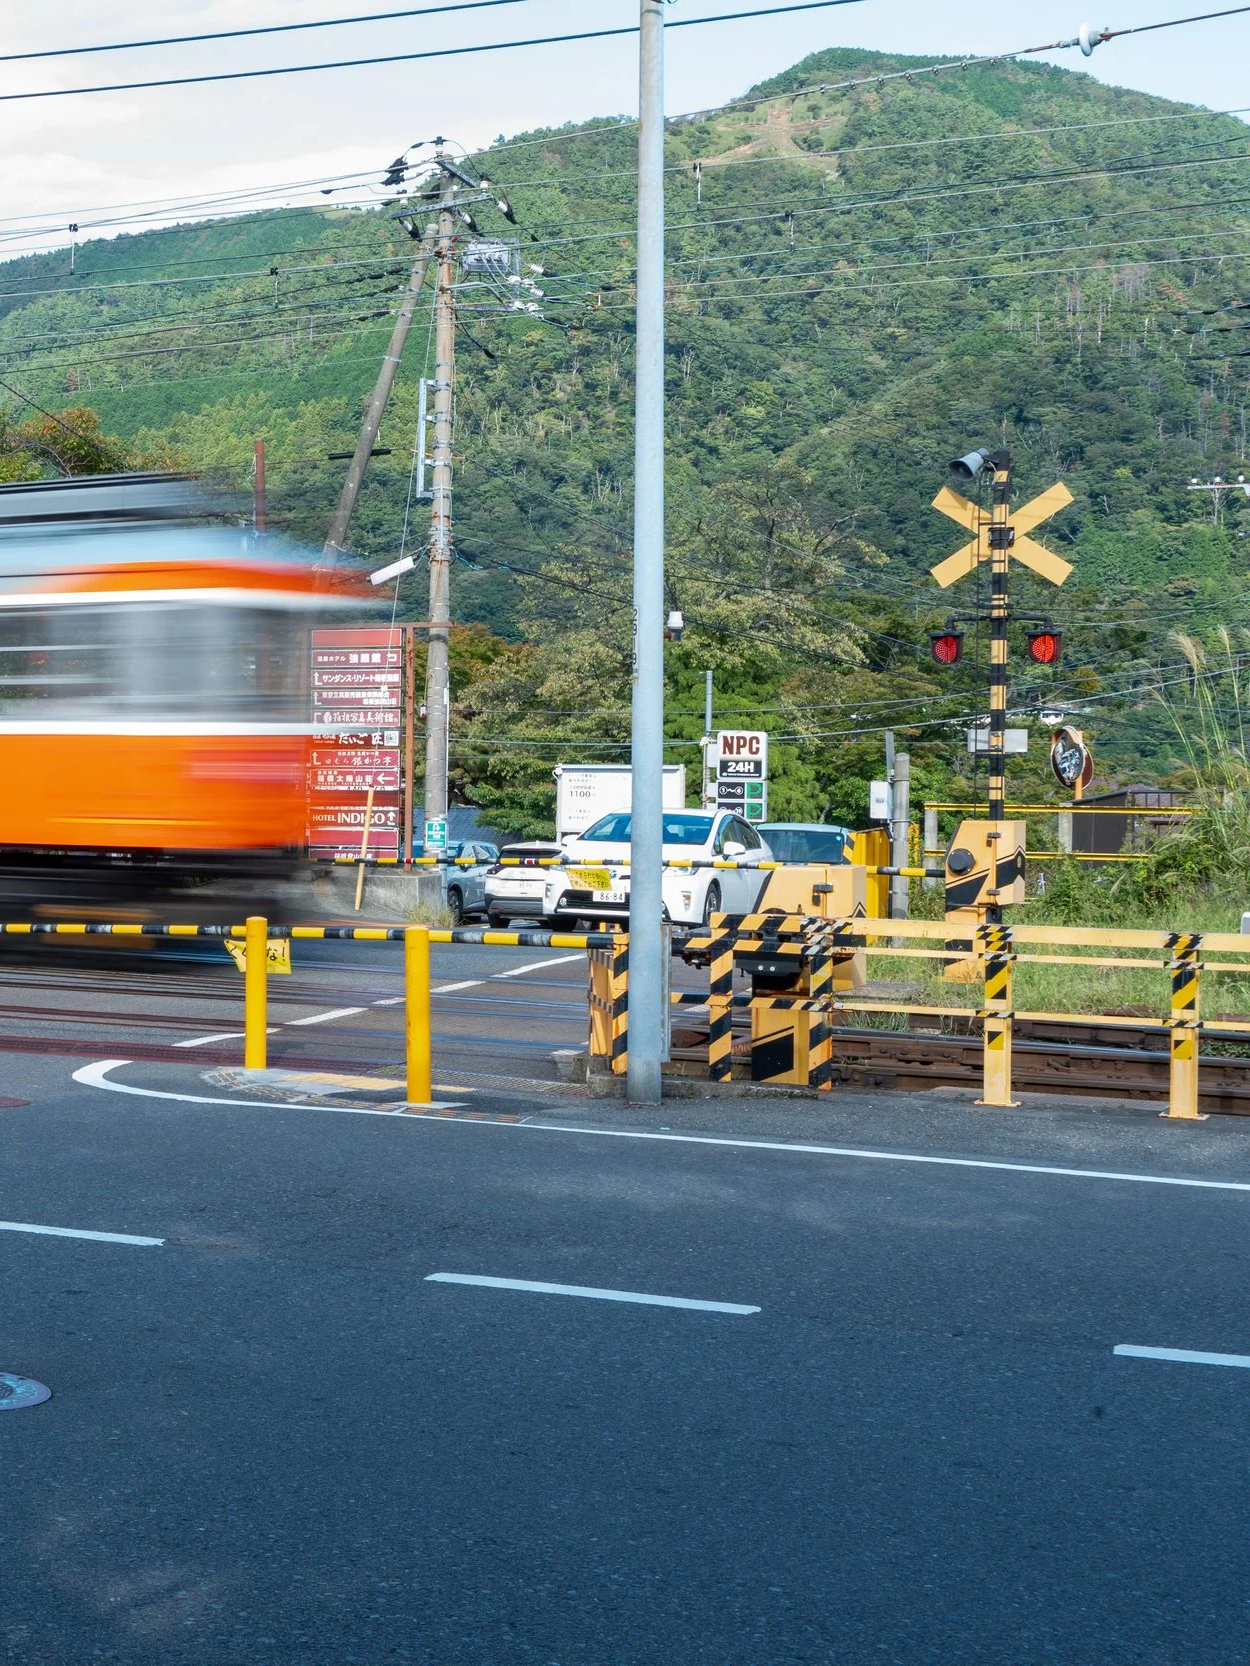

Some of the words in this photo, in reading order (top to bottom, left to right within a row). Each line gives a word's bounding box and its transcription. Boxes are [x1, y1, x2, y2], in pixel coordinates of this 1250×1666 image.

[338, 732, 368, 745] だいご
[722, 735, 760, 755] NPC
[727, 761, 755, 773] 24H
[337, 812, 385, 824] INDIGO
